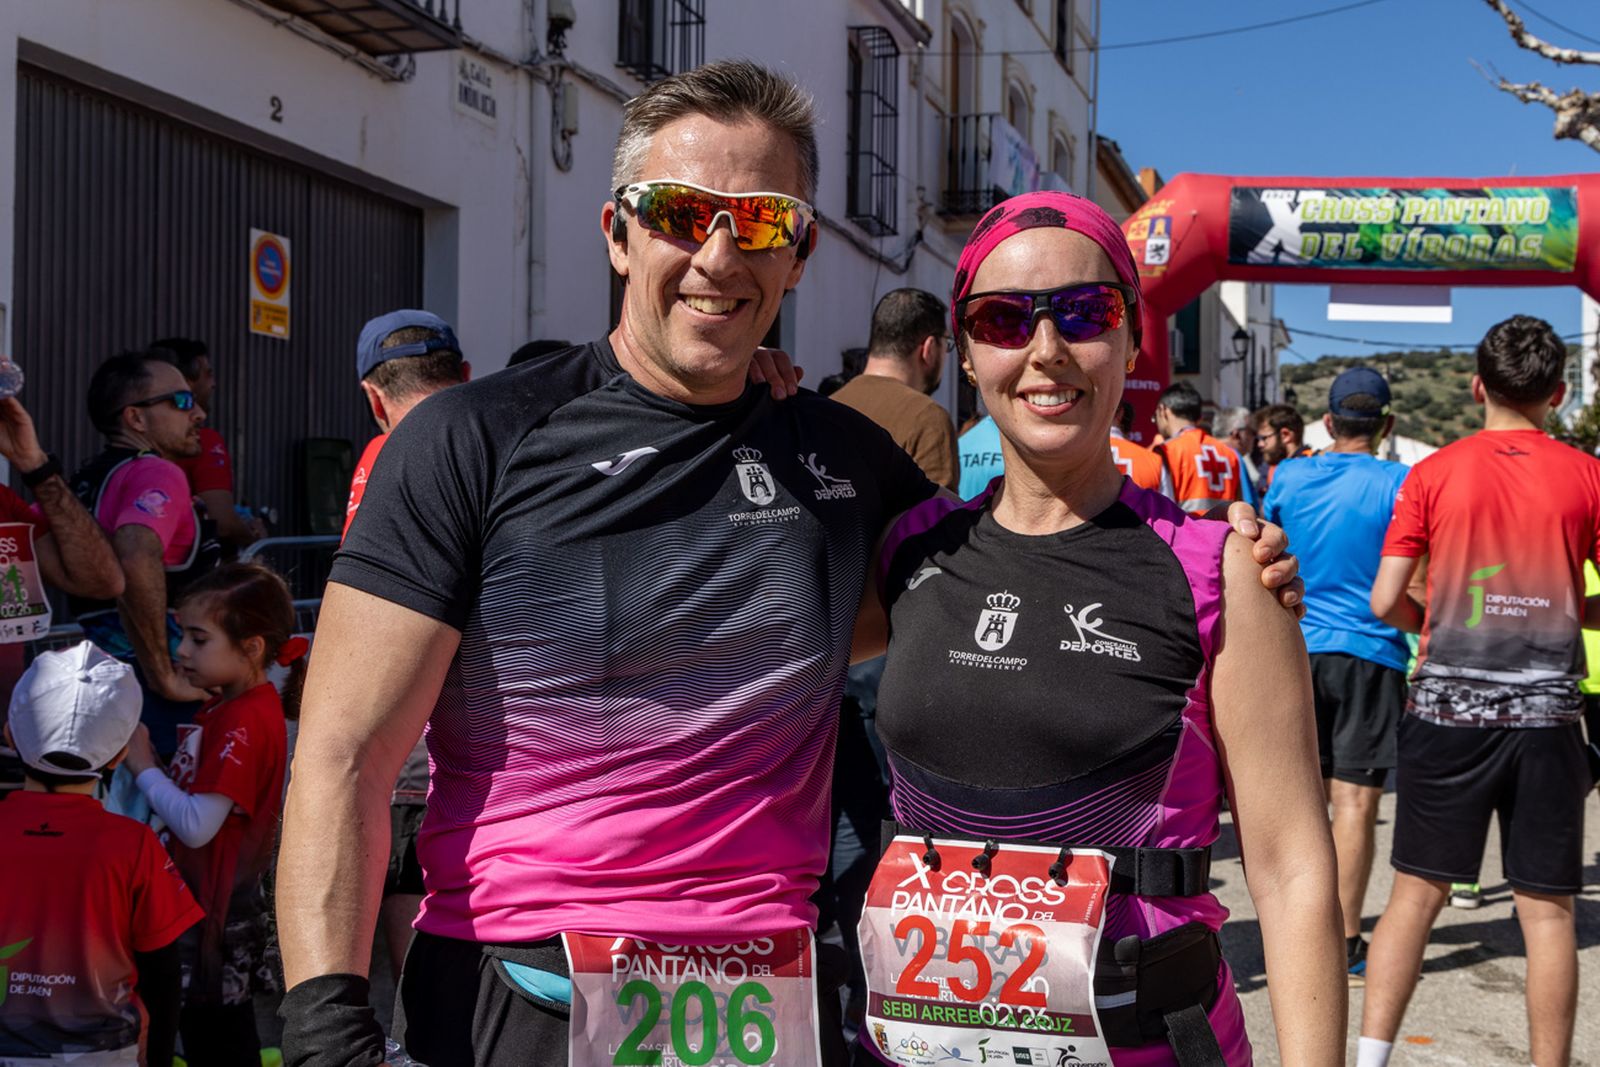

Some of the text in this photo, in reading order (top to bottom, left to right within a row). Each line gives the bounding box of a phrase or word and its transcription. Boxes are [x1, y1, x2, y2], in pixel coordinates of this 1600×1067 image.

[269, 95, 283, 124] 2
[1247, 190, 1550, 266] X CROSS PANTANO
[1299, 227, 1545, 263] DEL VÍBORAS
[728, 506, 801, 522] TORREDELCAMPO
[1485, 593, 1550, 608] DIPUTACIÓN
[1485, 605, 1501, 615] DE
[949, 650, 1028, 666] TORREDELCAMPO
[950, 658, 1023, 671] AYUNTAMIENTO
[1059, 640, 1142, 662] DEPORTES
[897, 852, 933, 889] X
[941, 870, 1066, 906] CROSS
[890, 890, 1057, 926] PANTANO DEL
[611, 954, 775, 985] PANTANO DEL
[894, 914, 1048, 1008] 252
[9, 984, 25, 994] DE
[10, 972, 76, 985] DIPUTACIÓN
[611, 979, 777, 1067] 206
[882, 999, 1076, 1034] SEBI ARREBOLA CRUZ
